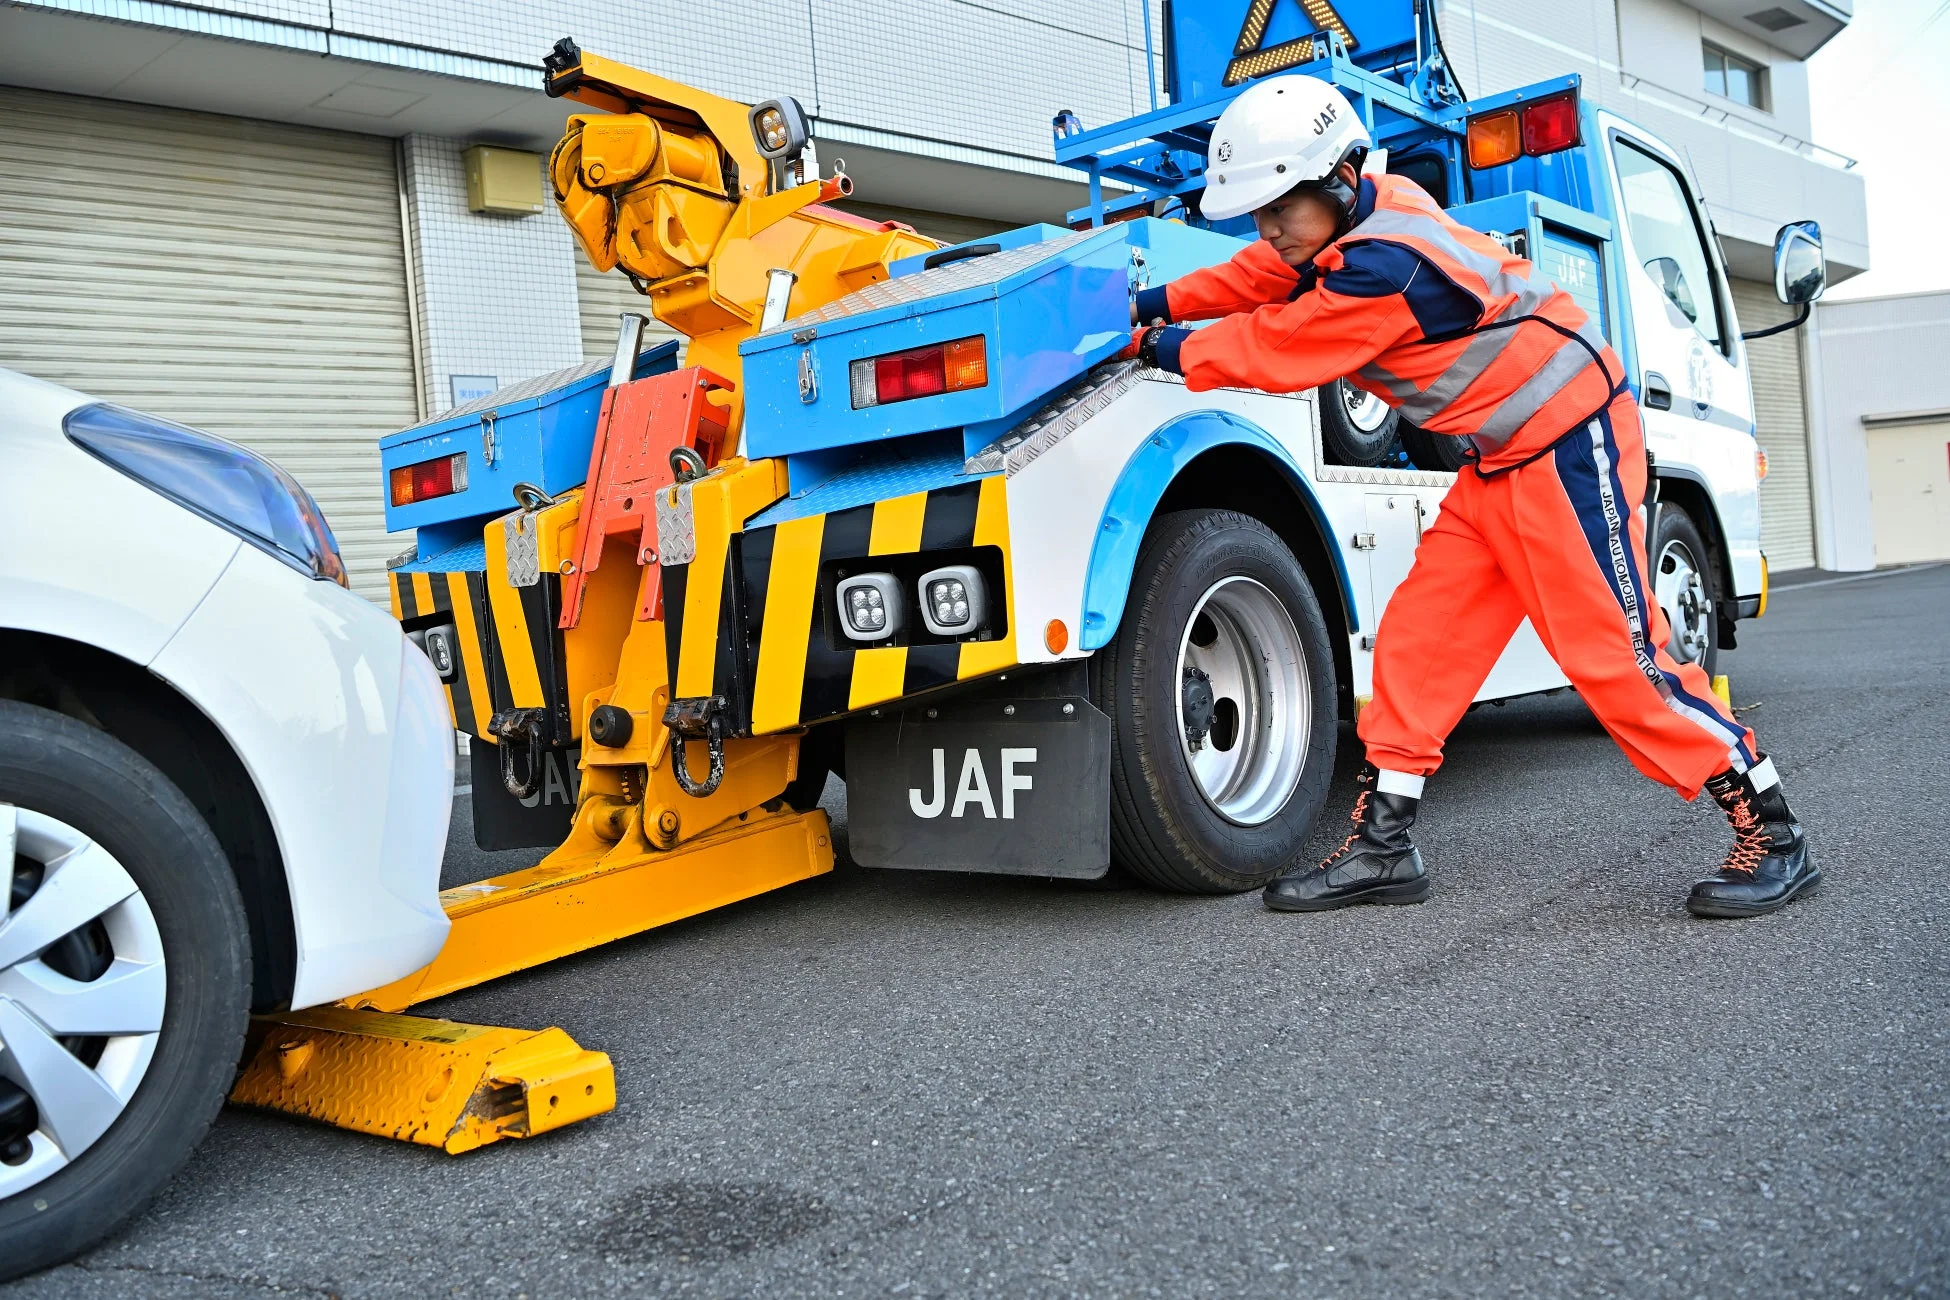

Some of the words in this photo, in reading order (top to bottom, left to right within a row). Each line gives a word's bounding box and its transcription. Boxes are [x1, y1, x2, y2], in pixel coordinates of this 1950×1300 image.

[1313, 103, 1337, 135] JAF
[1558, 254, 1586, 288] JAF
[1602, 492, 1619, 532] JAPAN
[1610, 538, 1639, 625] AUTOMOBILE
[908, 747, 1038, 820] JAF
